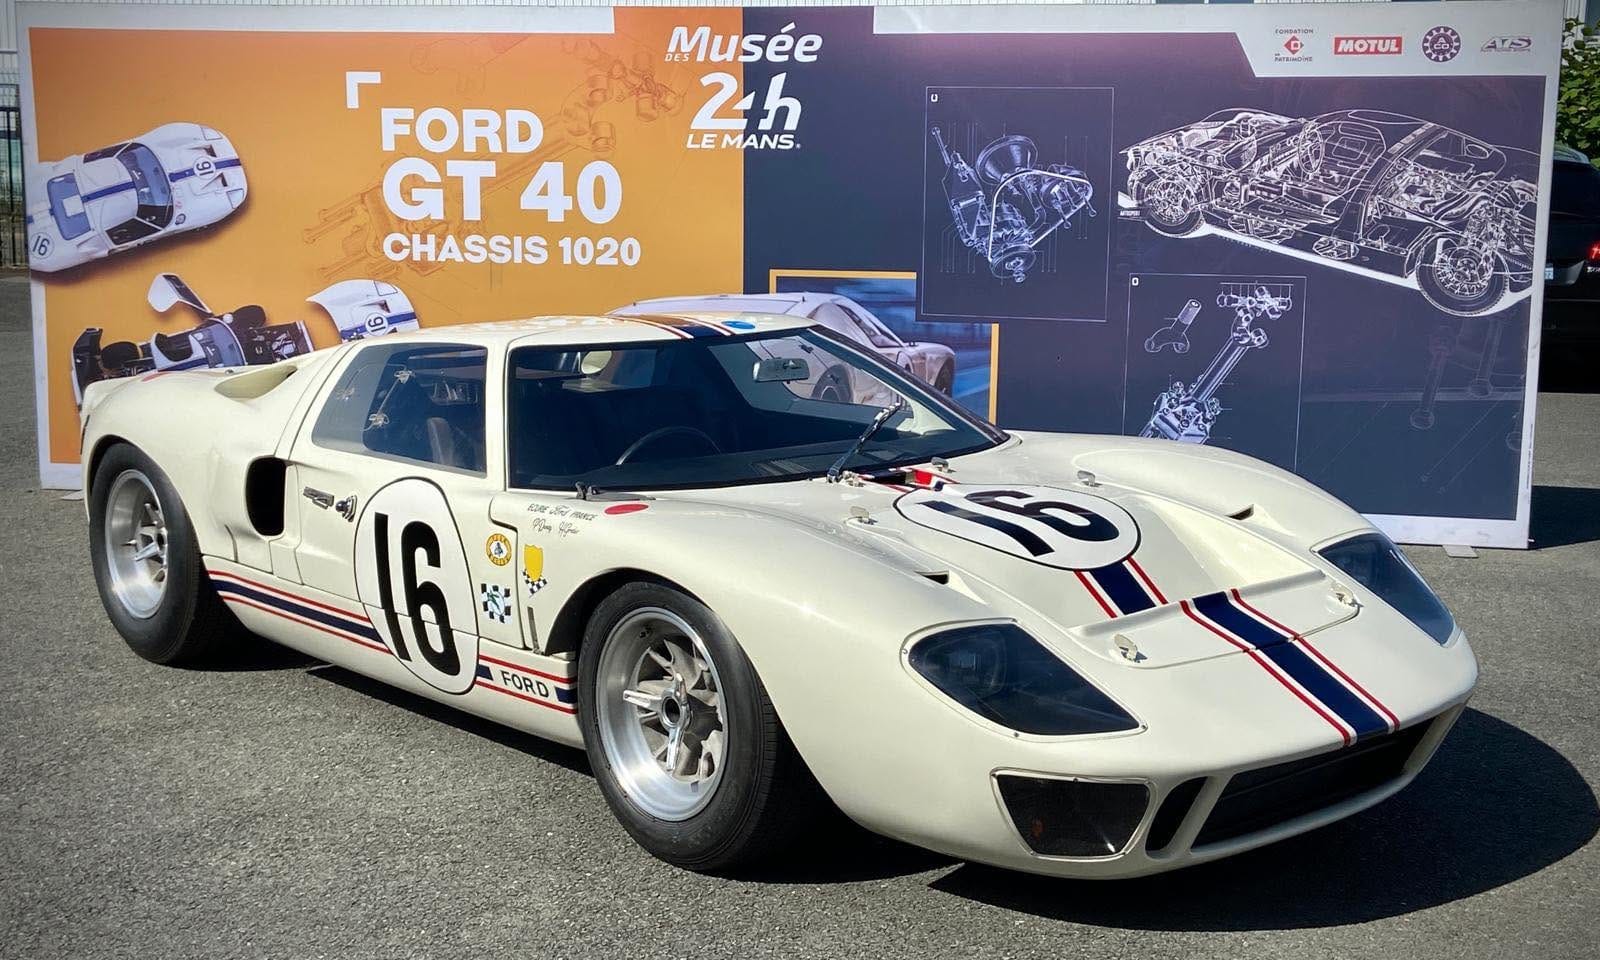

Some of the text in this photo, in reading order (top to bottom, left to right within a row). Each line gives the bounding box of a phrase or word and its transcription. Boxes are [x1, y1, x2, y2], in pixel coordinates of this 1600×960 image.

[665, 53, 690, 62] DES
[667, 22, 823, 63] Musée
[1338, 39, 1399, 53] MOTUL
[381, 107, 544, 153] FORD
[686, 134, 717, 149] LE
[382, 157, 623, 224] GT 40
[32, 235, 50, 256] 16
[383, 233, 641, 266] CHASSIS 1020
[916, 490, 1120, 557] 16
[375, 512, 460, 676] 16
[501, 670, 549, 698] FORD
